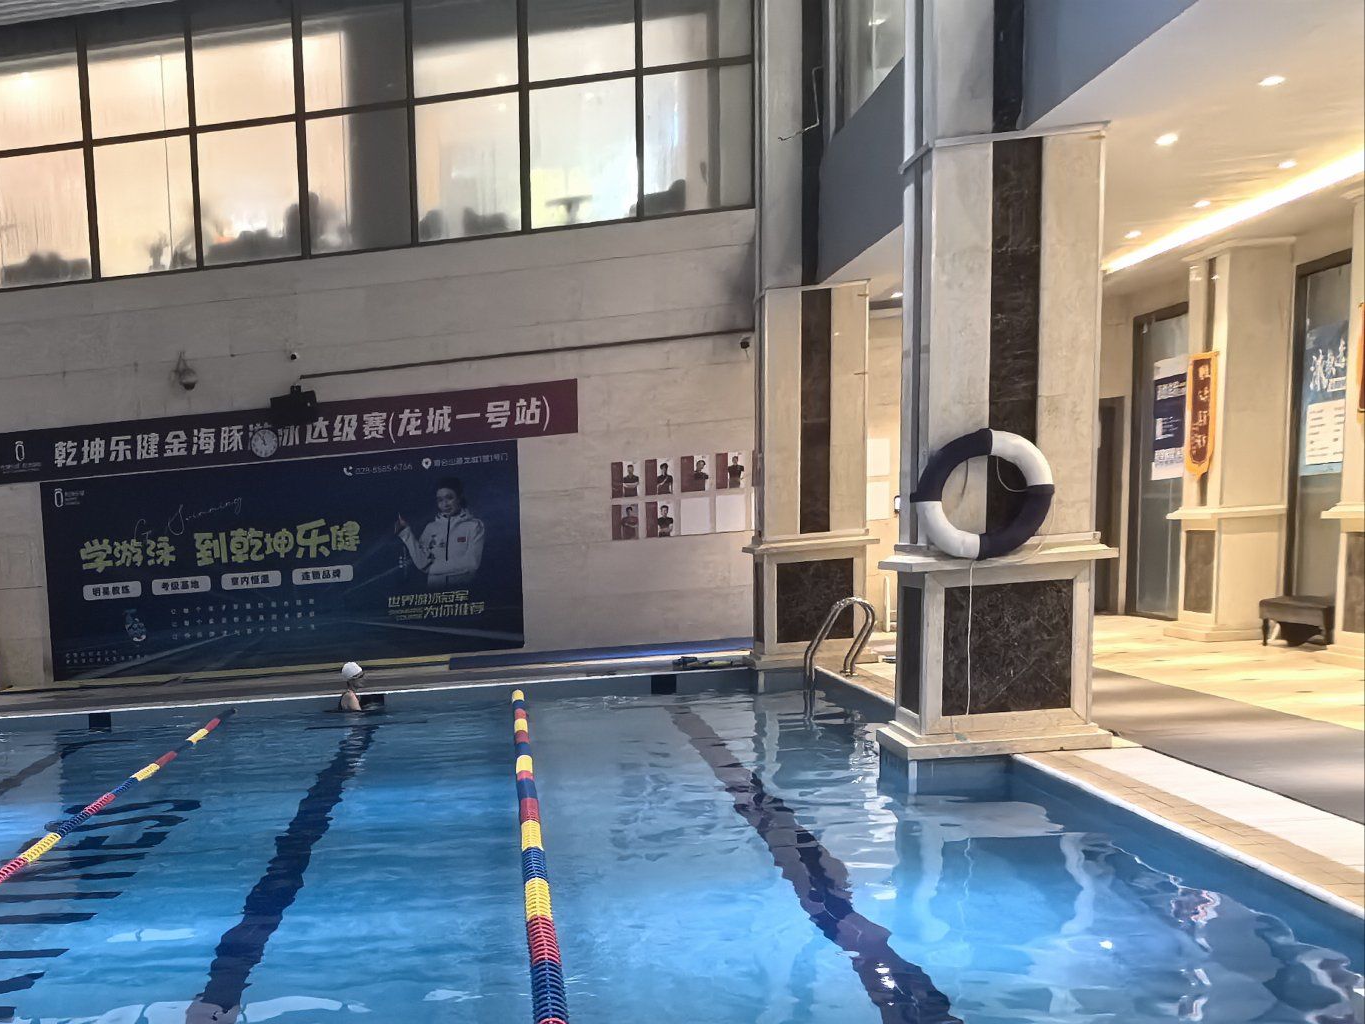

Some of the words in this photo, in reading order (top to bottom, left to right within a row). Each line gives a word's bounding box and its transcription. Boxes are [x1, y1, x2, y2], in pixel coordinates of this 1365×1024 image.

[53, 395, 551, 468] 乾坤乐健金海豚泳达级赛(龙城一号站)
[79, 535, 176, 574] 学游泳
[193, 518, 361, 567] 到乾坤乐健
